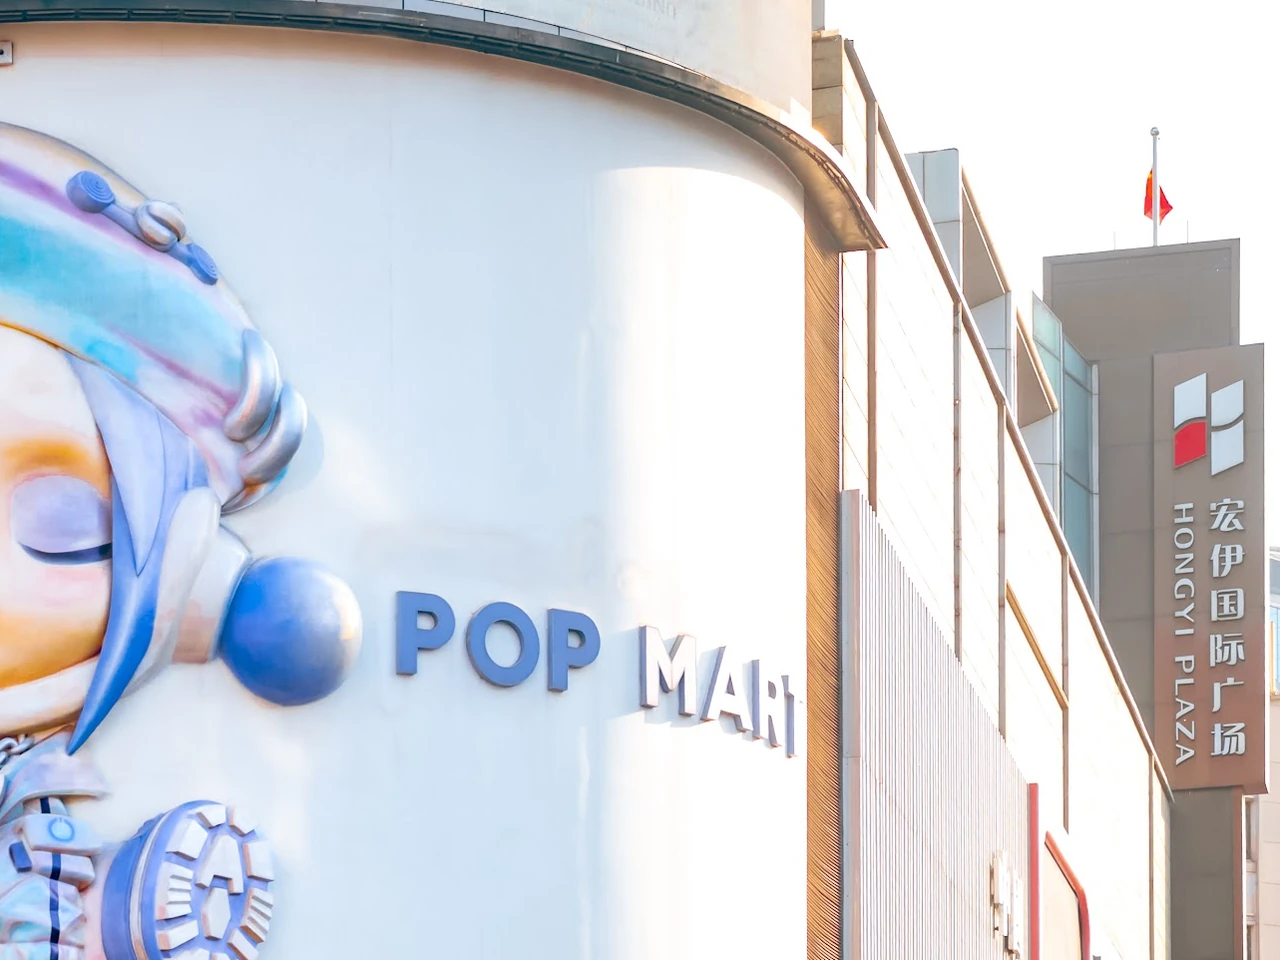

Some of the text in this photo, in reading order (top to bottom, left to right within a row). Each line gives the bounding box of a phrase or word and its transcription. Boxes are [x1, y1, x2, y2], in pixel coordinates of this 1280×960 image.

[396, 590, 601, 692] POP
[1173, 502, 1195, 766] HONGYI PLAZA
[1209, 497, 1246, 757] 宏伊国际广场
